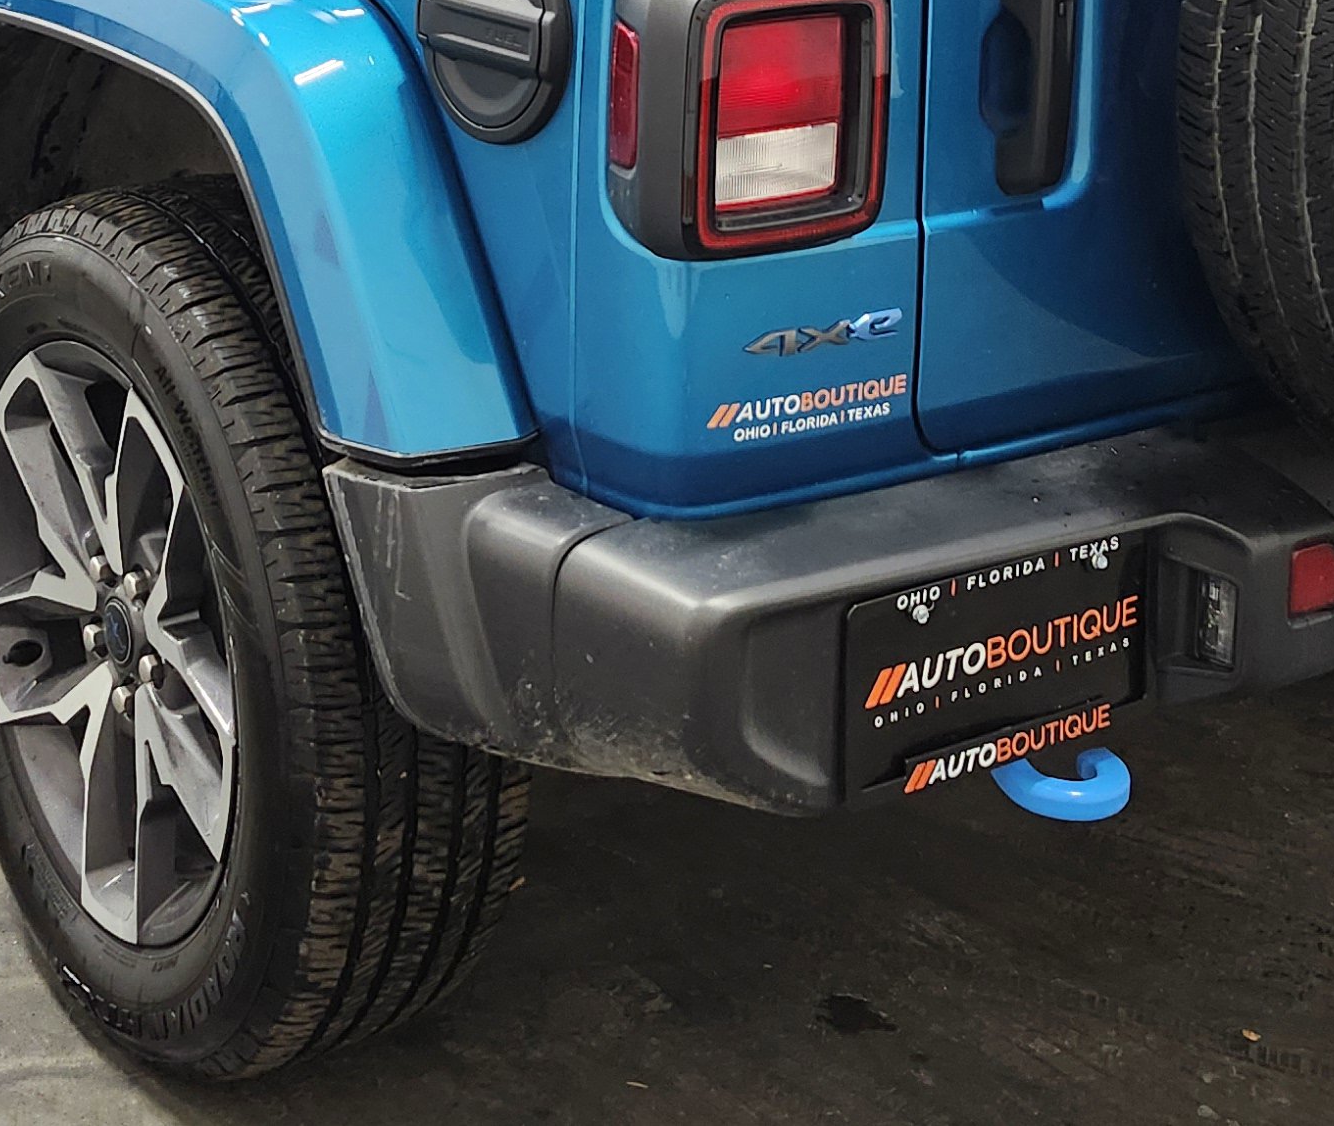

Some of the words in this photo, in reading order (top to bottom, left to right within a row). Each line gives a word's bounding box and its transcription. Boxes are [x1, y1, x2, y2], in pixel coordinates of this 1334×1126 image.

[733, 424, 771, 442] OHIO
[781, 413, 838, 434] FLORIDA
[847, 401, 891, 421] TEXAS
[735, 373, 908, 424] AUTOBOUTIQUE
[896, 585, 941, 610] OHIO
[967, 557, 1046, 590] FLORIDA
[1069, 536, 1119, 561] TEXAS
[874, 702, 925, 728] OHIO
[951, 666, 1042, 703] FLORIDA
[1072, 637, 1130, 666] TEXAS
[896, 595, 1139, 698] AUTOBOUTIQUE
[928, 703, 1111, 784] AUTOBOUTIQUE
